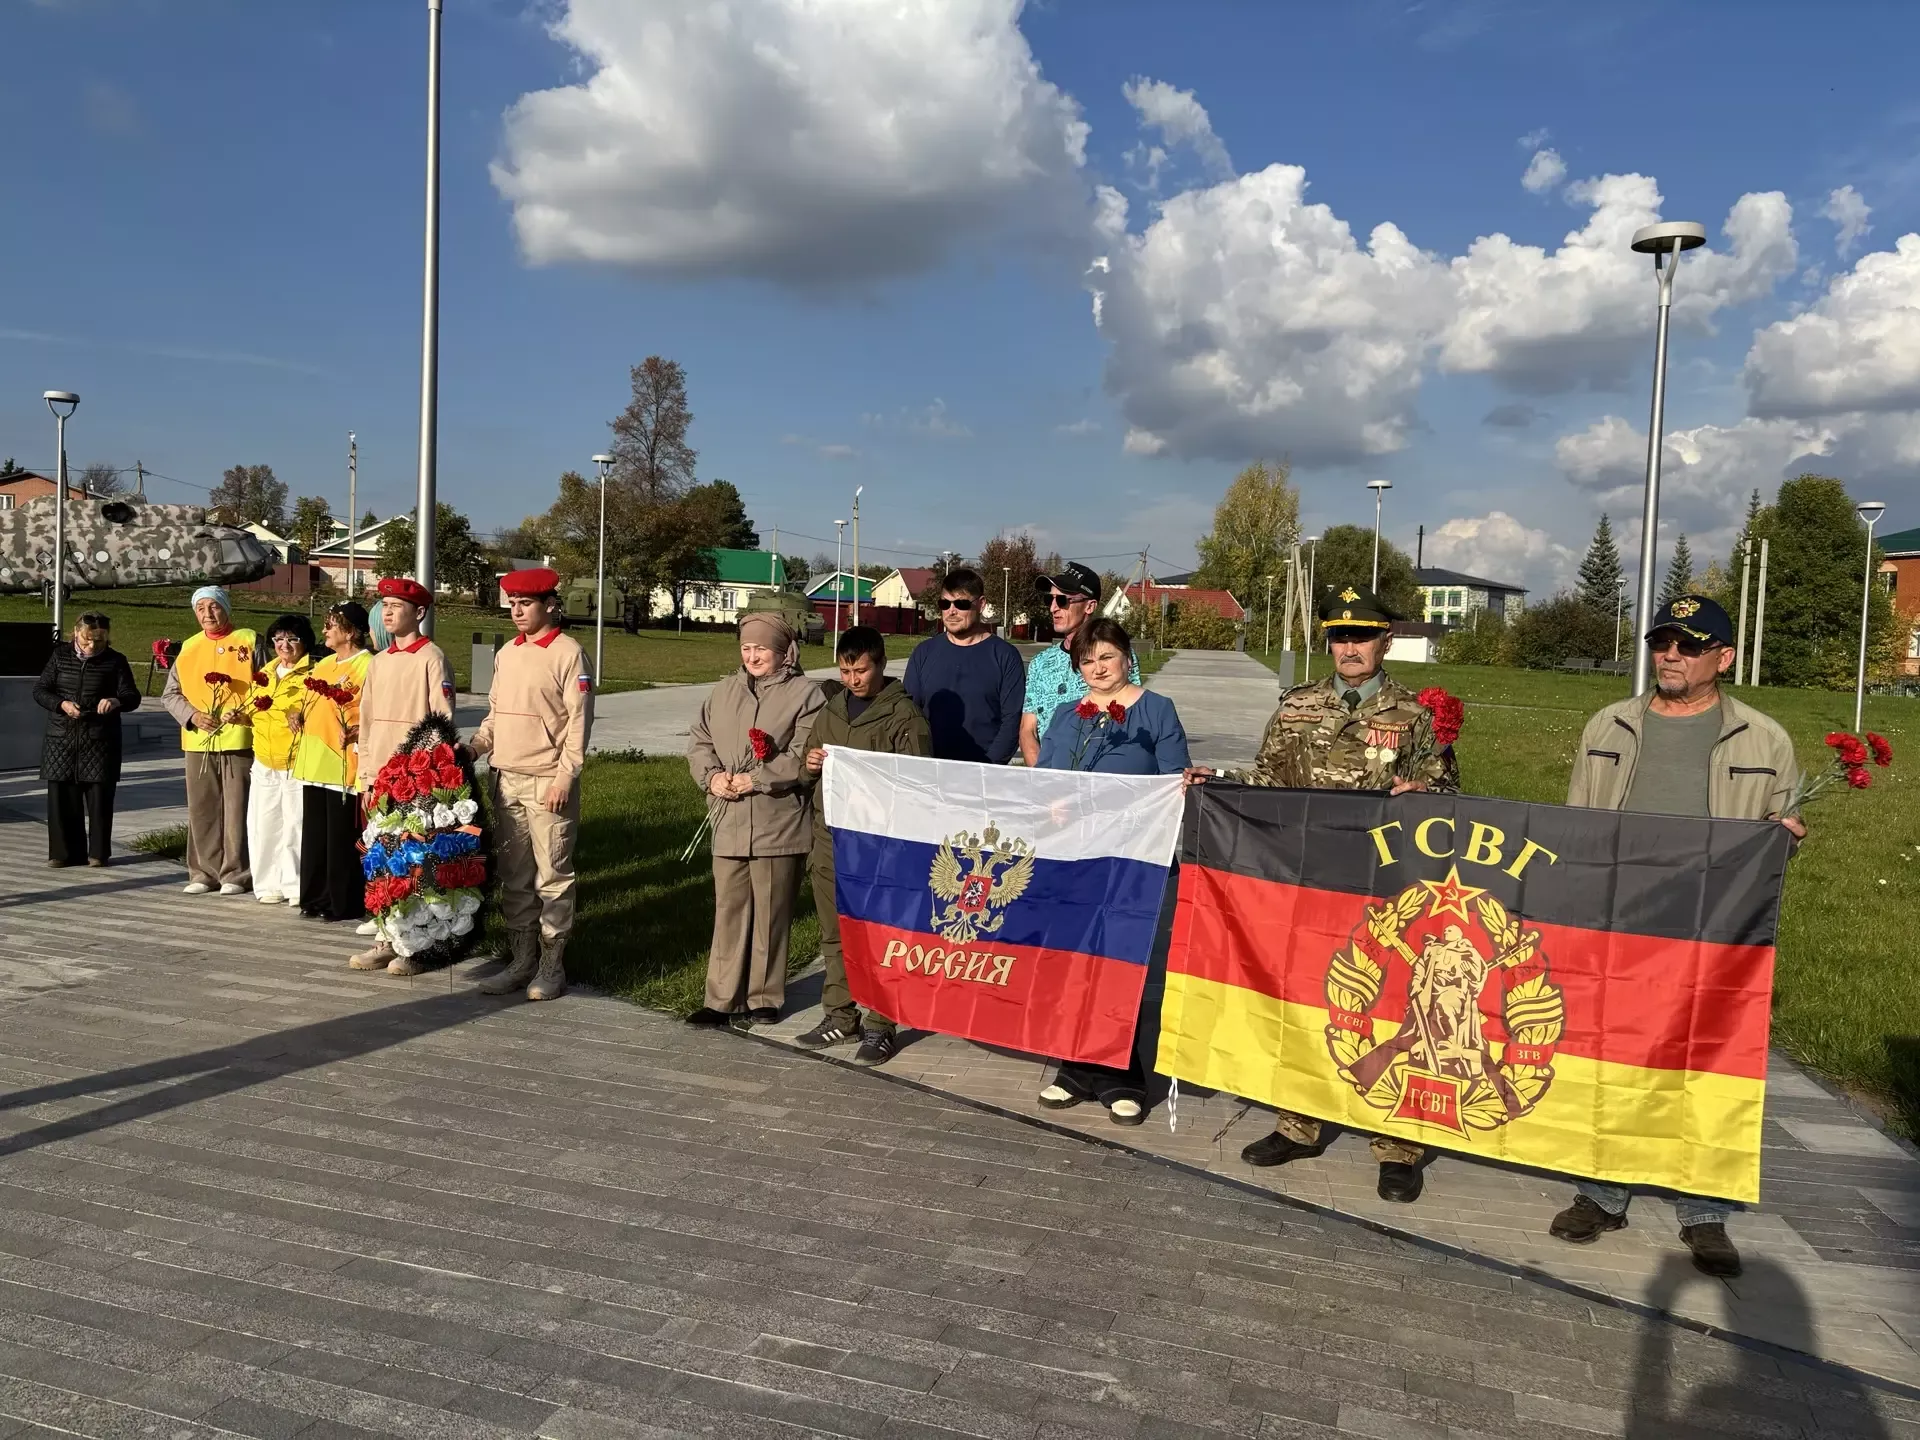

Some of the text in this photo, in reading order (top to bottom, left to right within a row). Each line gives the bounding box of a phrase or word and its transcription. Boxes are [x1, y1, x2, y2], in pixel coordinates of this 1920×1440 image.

[1367, 817, 1558, 881] ГСВГ
[880, 939, 1017, 986] РОССИЯ
[1336, 1012, 1368, 1029] ГСВГ
[1516, 1049, 1541, 1061] ЗГВ
[1410, 1087, 1452, 1115] ГСВГ
